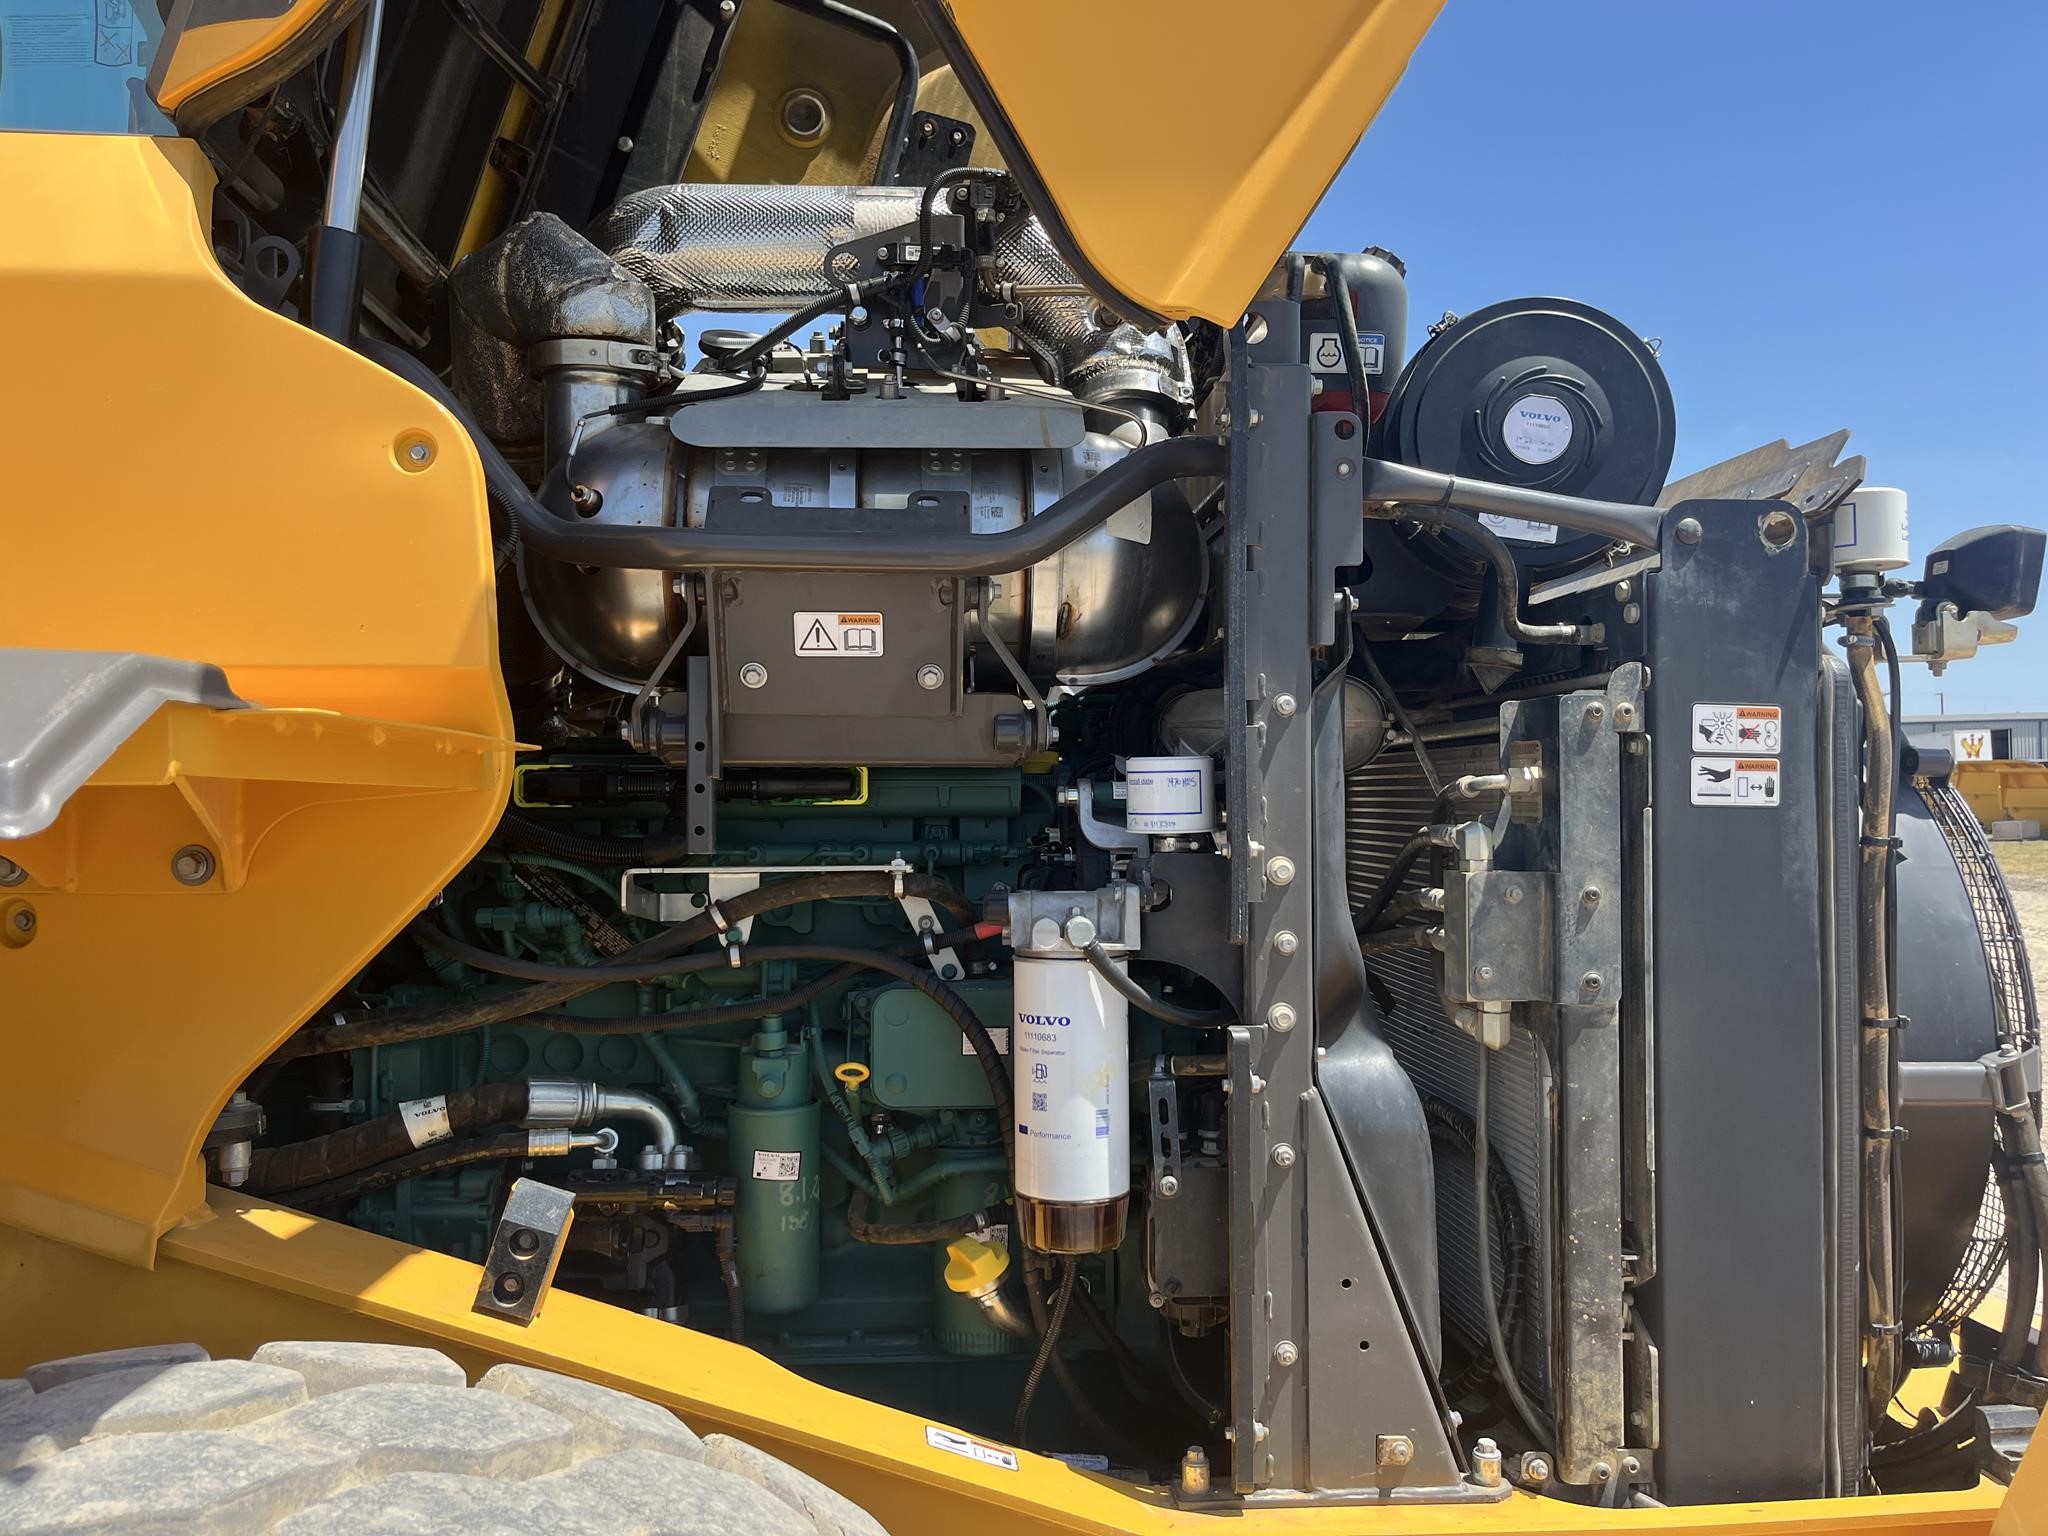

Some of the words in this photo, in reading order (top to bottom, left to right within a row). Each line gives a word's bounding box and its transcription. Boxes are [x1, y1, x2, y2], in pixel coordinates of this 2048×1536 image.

[1520, 410, 1561, 423] VOLVO
[1745, 711, 1777, 719] WARNING
[1018, 1013, 1072, 1027] VOLVO
[1024, 1031, 1057, 1042] 11110683
[414, 1106, 446, 1117] VOLVO
[1029, 1129, 1072, 1141] Performance
